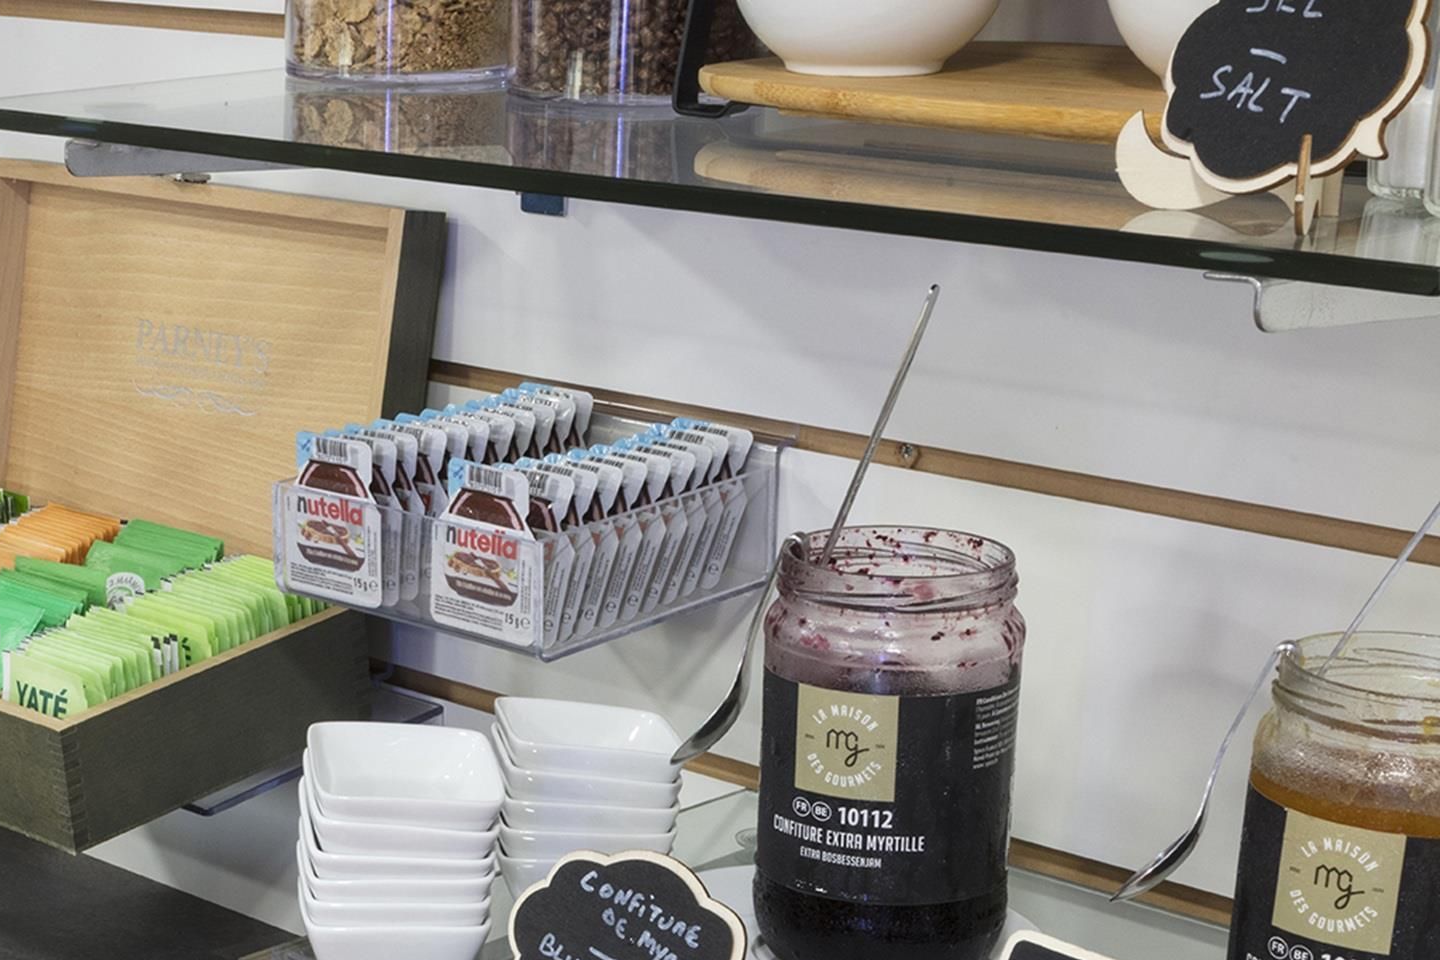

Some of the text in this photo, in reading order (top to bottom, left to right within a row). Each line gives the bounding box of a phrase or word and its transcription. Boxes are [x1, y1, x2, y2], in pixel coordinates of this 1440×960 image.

[1200, 65, 1311, 123] SALT
[297, 495, 364, 526] nutella
[15, 680, 69, 718] YATÉ
[812, 704, 879, 732] LA MAISON
[807, 752, 881, 788] DES GOURMETS
[796, 801, 894, 829] FR BE 10112
[773, 813, 925, 853] CONFITURE EXTRA MYRTILLE
[800, 845, 882, 869] EXTRA BOSBESSENJAM
[1300, 837, 1380, 872] LA MAISON
[580, 870, 702, 949] CONFITURE
[602, 907, 627, 939] DE
[1289, 889, 1379, 933] DES GOURMETS
[1271, 941, 1286, 954] FR
